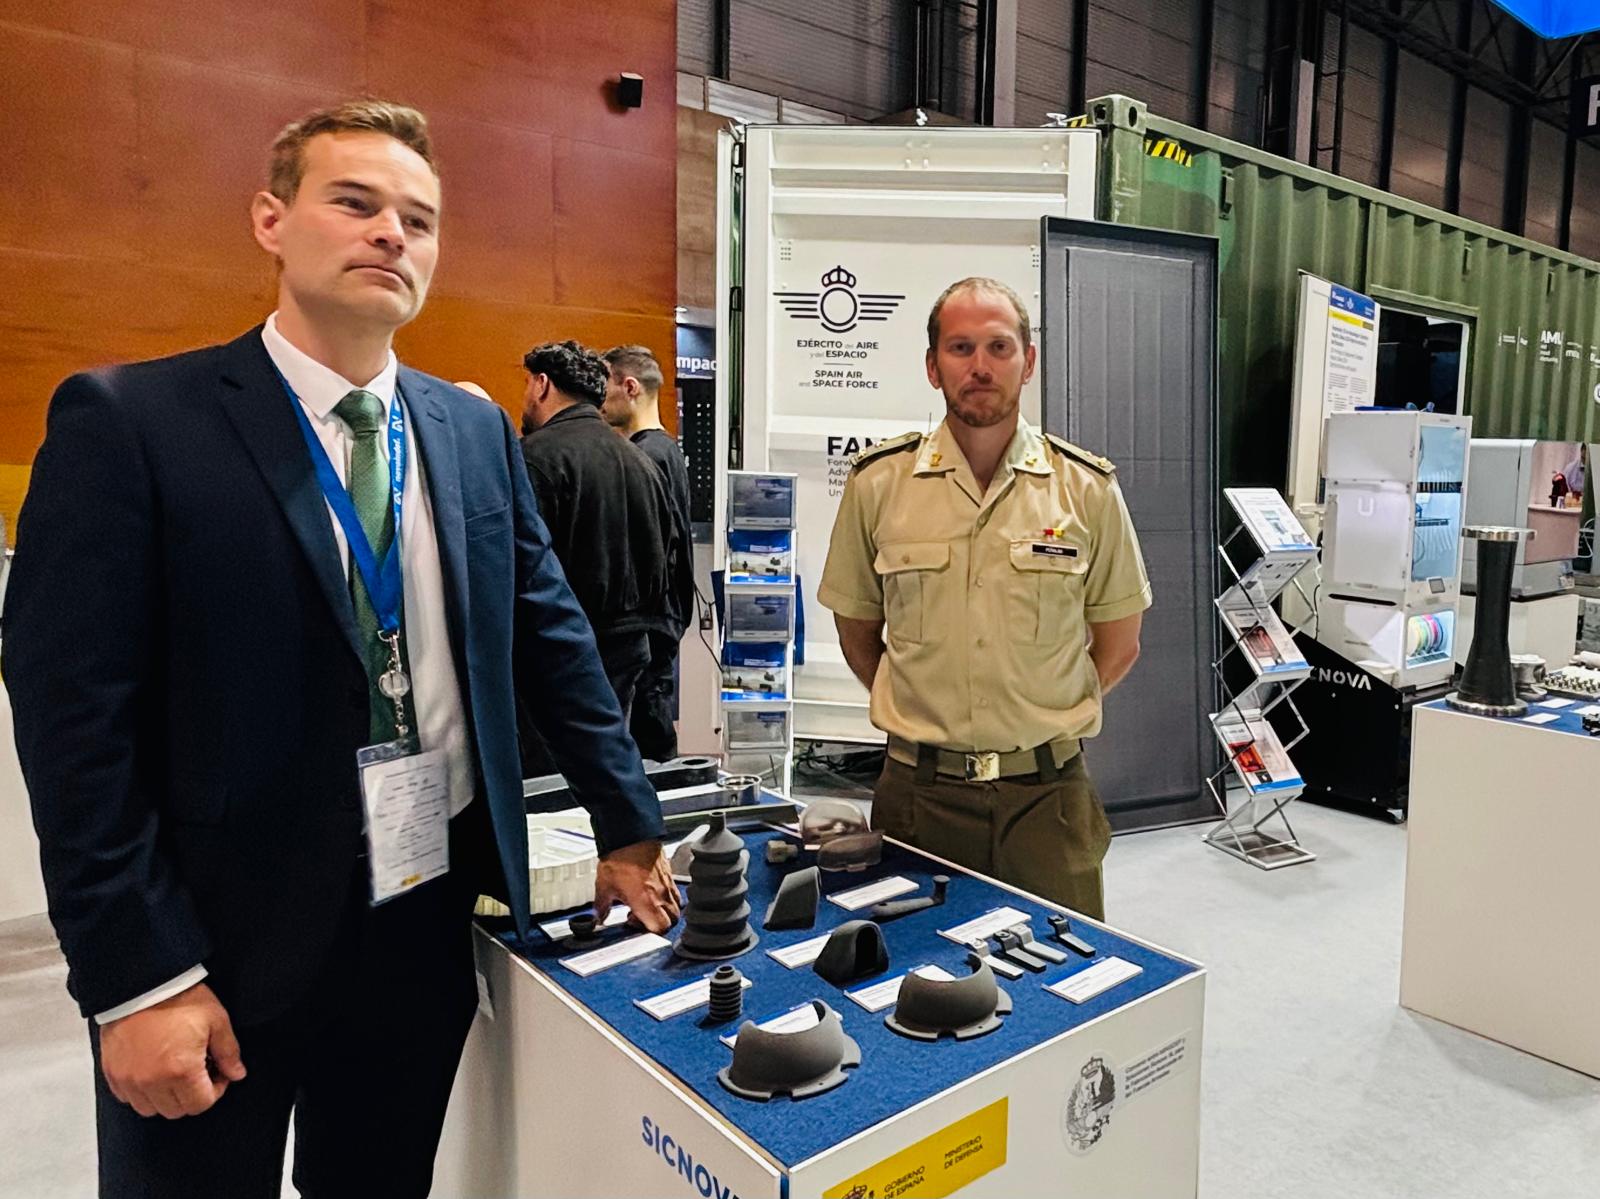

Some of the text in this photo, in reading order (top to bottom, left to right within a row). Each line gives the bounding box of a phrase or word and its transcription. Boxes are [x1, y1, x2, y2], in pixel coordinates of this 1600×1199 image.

[797, 338, 843, 348] EJÉRCITO
[856, 341, 879, 350] AIRE
[825, 350, 868, 359] ESPACIO
[812, 379, 845, 388] SPACE
[846, 380, 879, 389] FORCE
[814, 369, 863, 379] SPAIN AIR
[641, 1115, 742, 1199] SICNOV
[944, 1135, 983, 1159] MINISTERIO
[944, 1143, 984, 1170] DE DEFENSA
[884, 1166, 926, 1193] GOBIERNO
[896, 1175, 926, 1197] ESPAÑA
